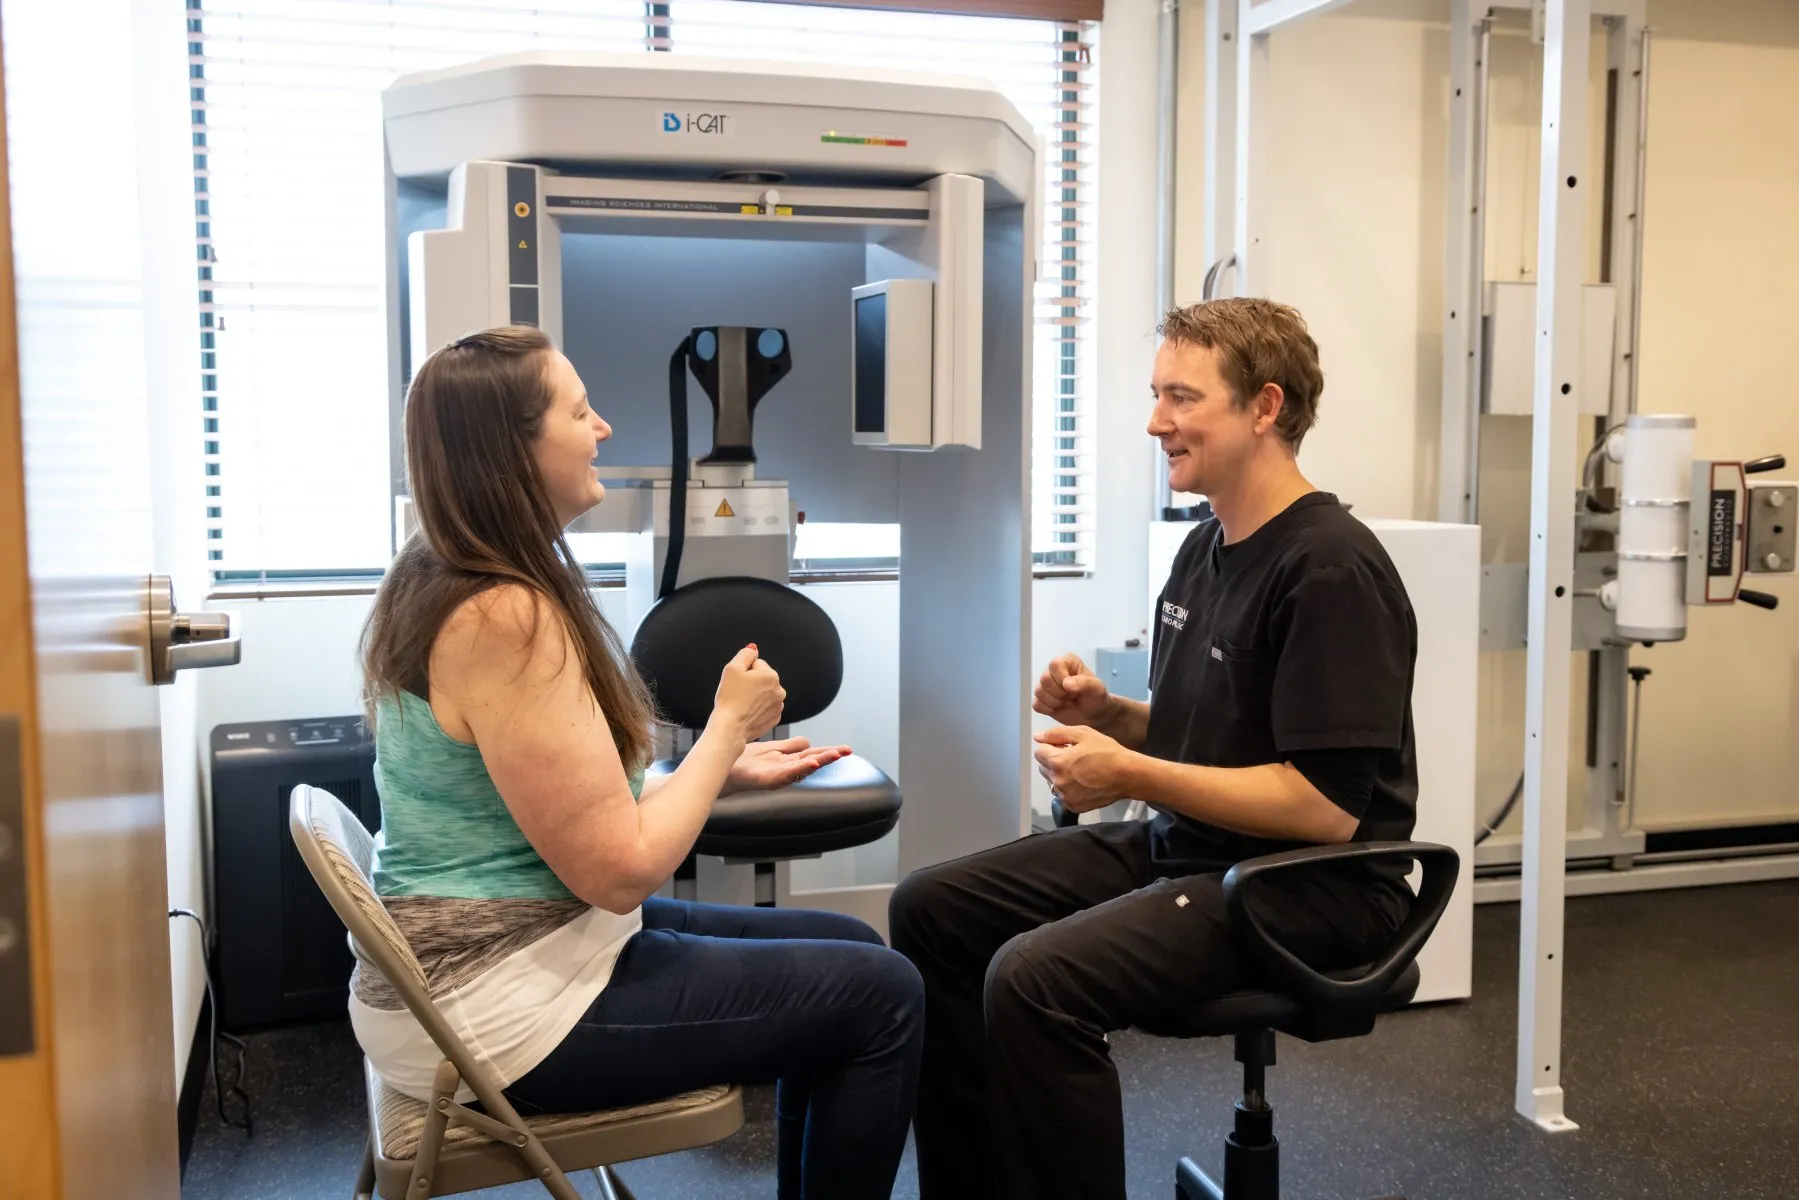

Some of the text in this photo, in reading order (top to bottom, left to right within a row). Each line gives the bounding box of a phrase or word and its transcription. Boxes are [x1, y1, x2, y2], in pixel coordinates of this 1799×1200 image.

[687, 113, 727, 134] i-CAT
[609, 200, 651, 208] SCIENCES
[653, 202, 718, 211] INTERNATIONAL
[1711, 498, 1724, 568] PRECISION
